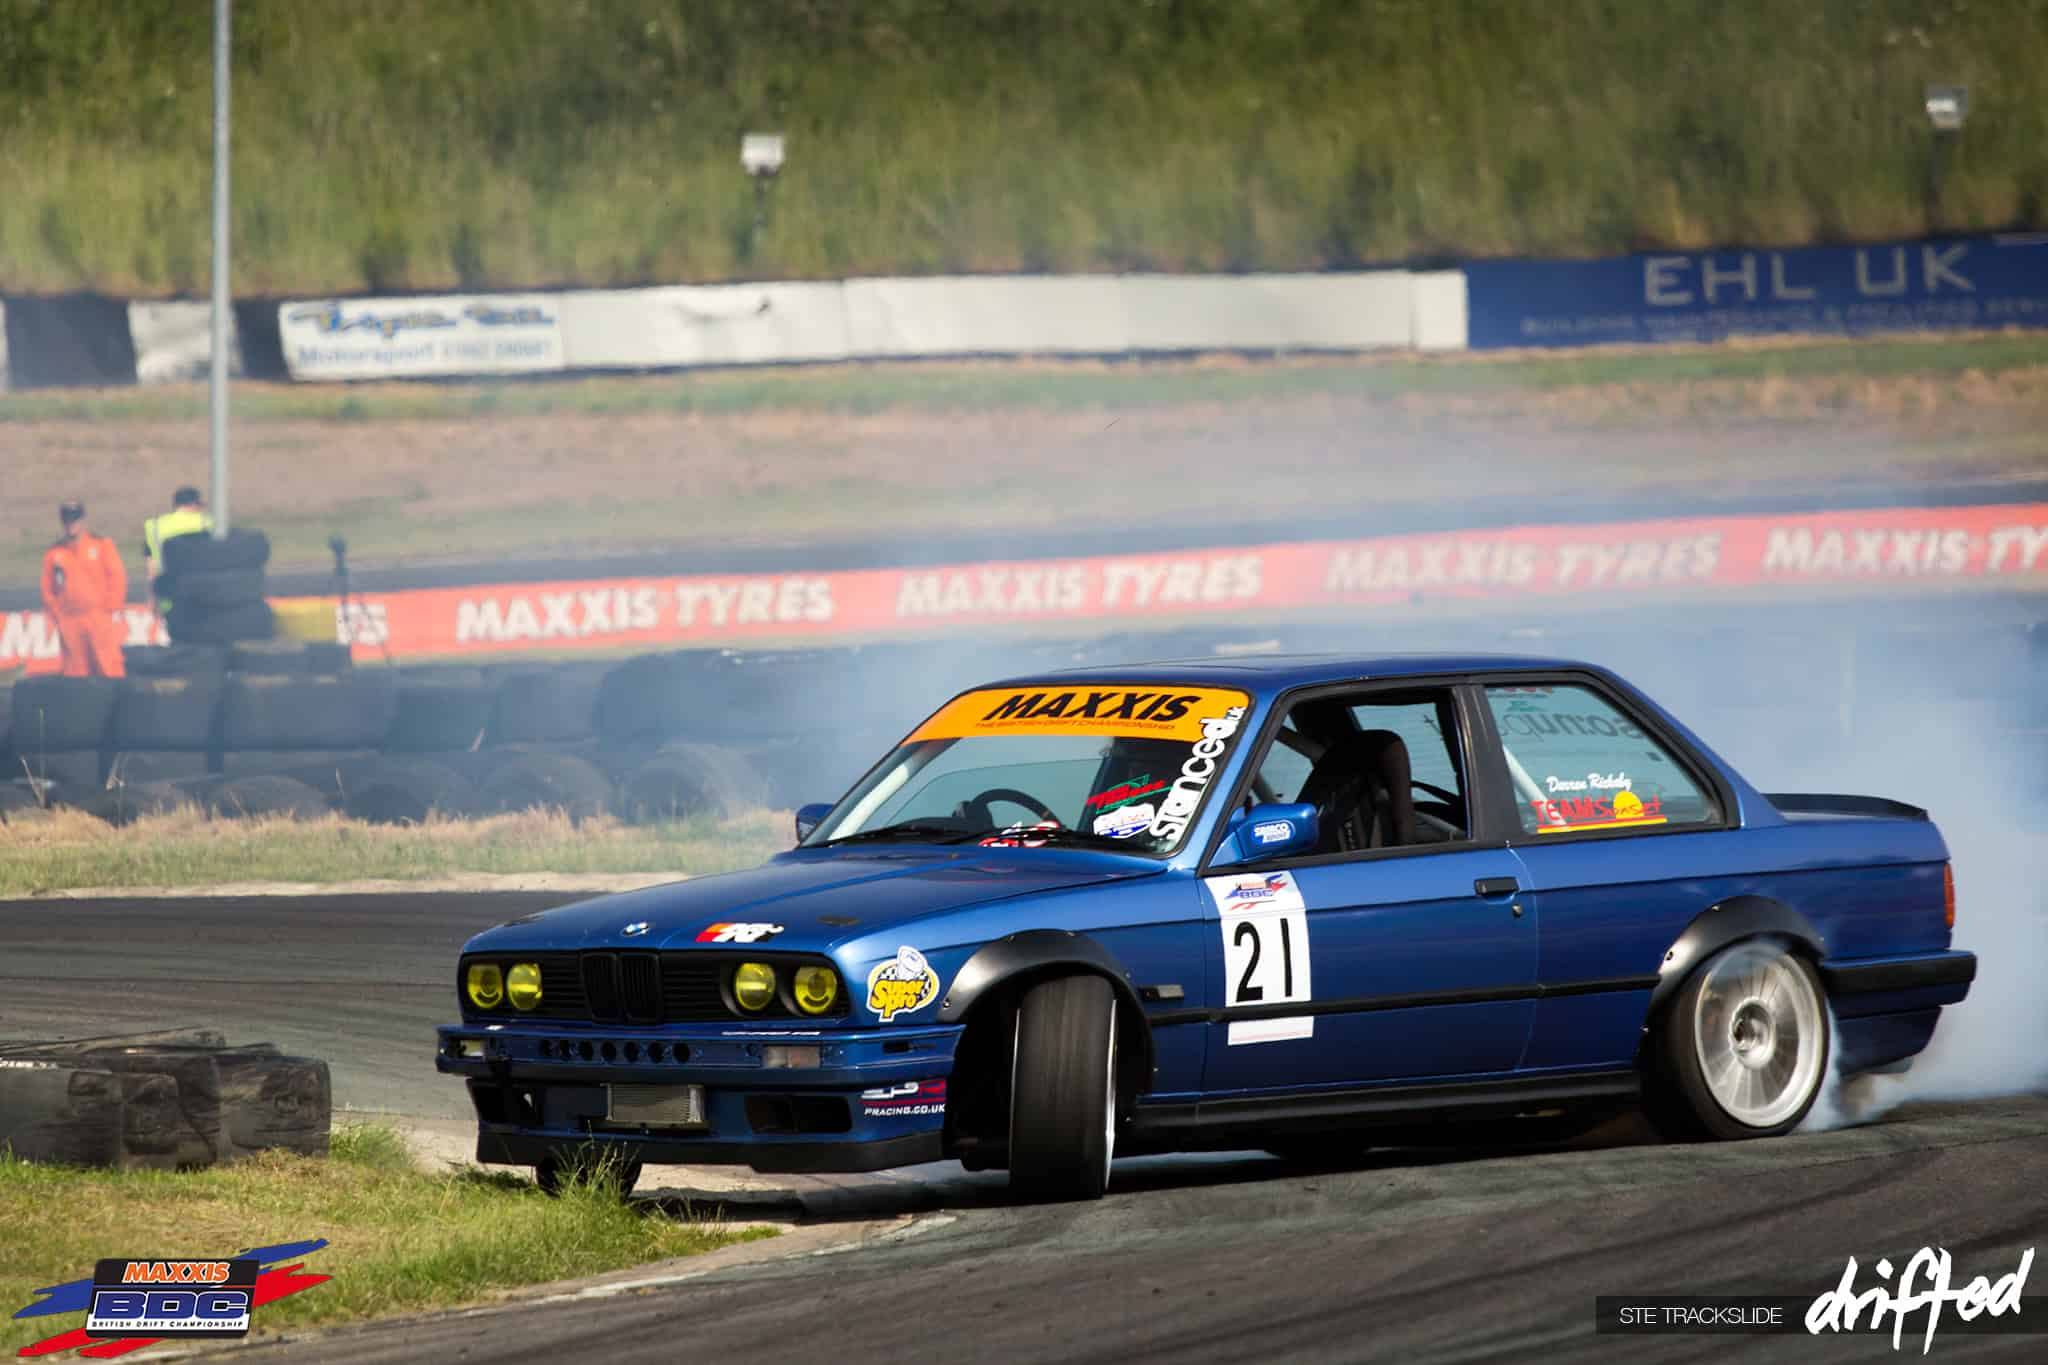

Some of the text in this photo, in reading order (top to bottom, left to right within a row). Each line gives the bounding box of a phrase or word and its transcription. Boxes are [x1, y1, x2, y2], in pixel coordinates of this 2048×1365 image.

[1643, 244, 1977, 306] EHL UK
[1324, 530, 1723, 592] MAXXIS TYRES
[1763, 526, 1969, 576] MAXXIS
[456, 577, 834, 642] MAXXIS TYRES
[896, 555, 1263, 616] MAXXIS TYRES
[982, 692, 1202, 721] MAXXIS
[1234, 918, 1293, 1003] 21
